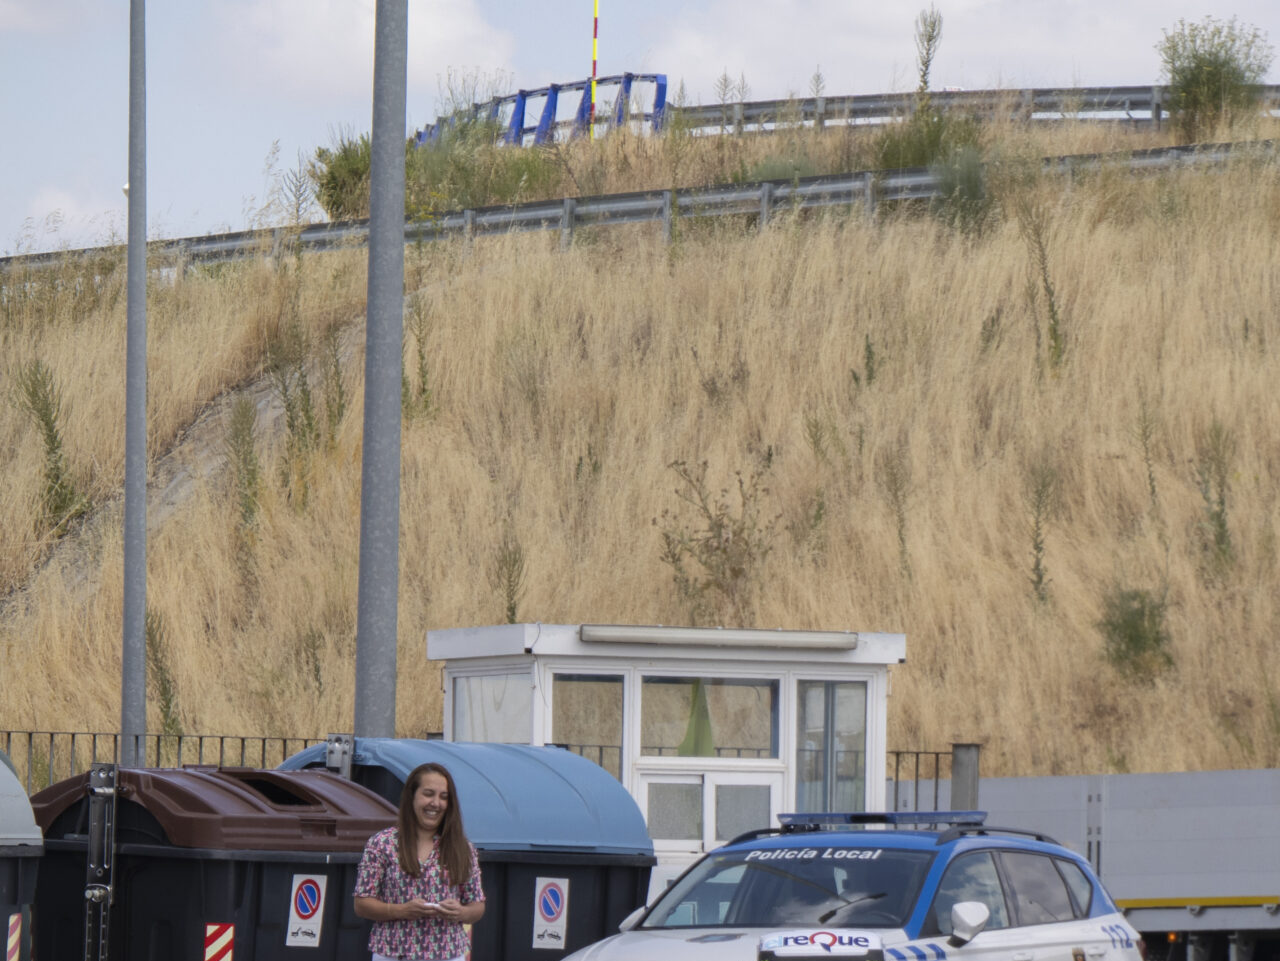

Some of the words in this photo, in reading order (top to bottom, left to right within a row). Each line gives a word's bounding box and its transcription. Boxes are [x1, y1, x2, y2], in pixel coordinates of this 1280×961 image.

[744, 848, 818, 862] Policía
[821, 847, 882, 860] Local
[1100, 924, 1134, 949] 112
